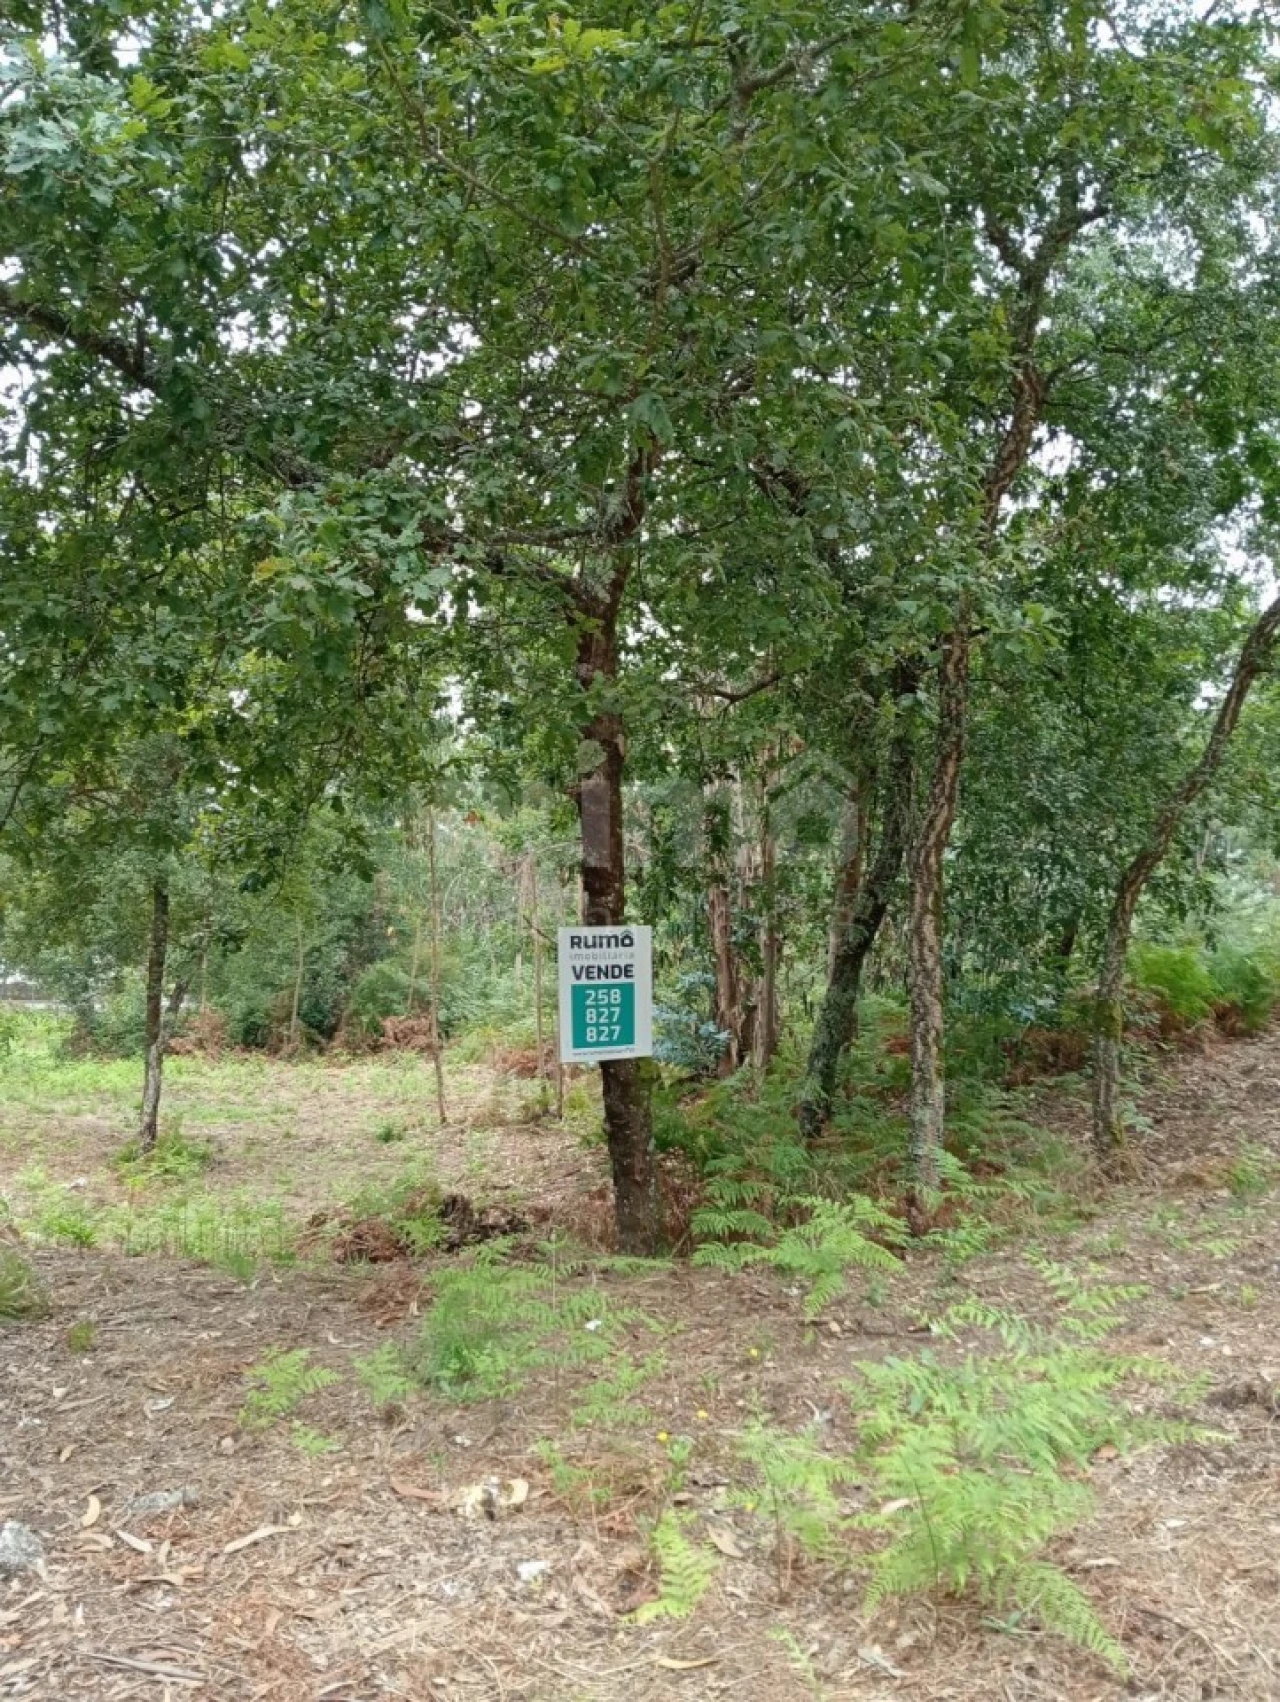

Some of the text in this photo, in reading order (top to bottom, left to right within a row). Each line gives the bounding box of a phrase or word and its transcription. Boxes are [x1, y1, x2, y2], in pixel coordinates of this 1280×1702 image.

[572, 964, 634, 980] VENDE
[585, 989, 621, 1005] 258
[586, 1007, 620, 1023] 827
[586, 1025, 620, 1042] 827
